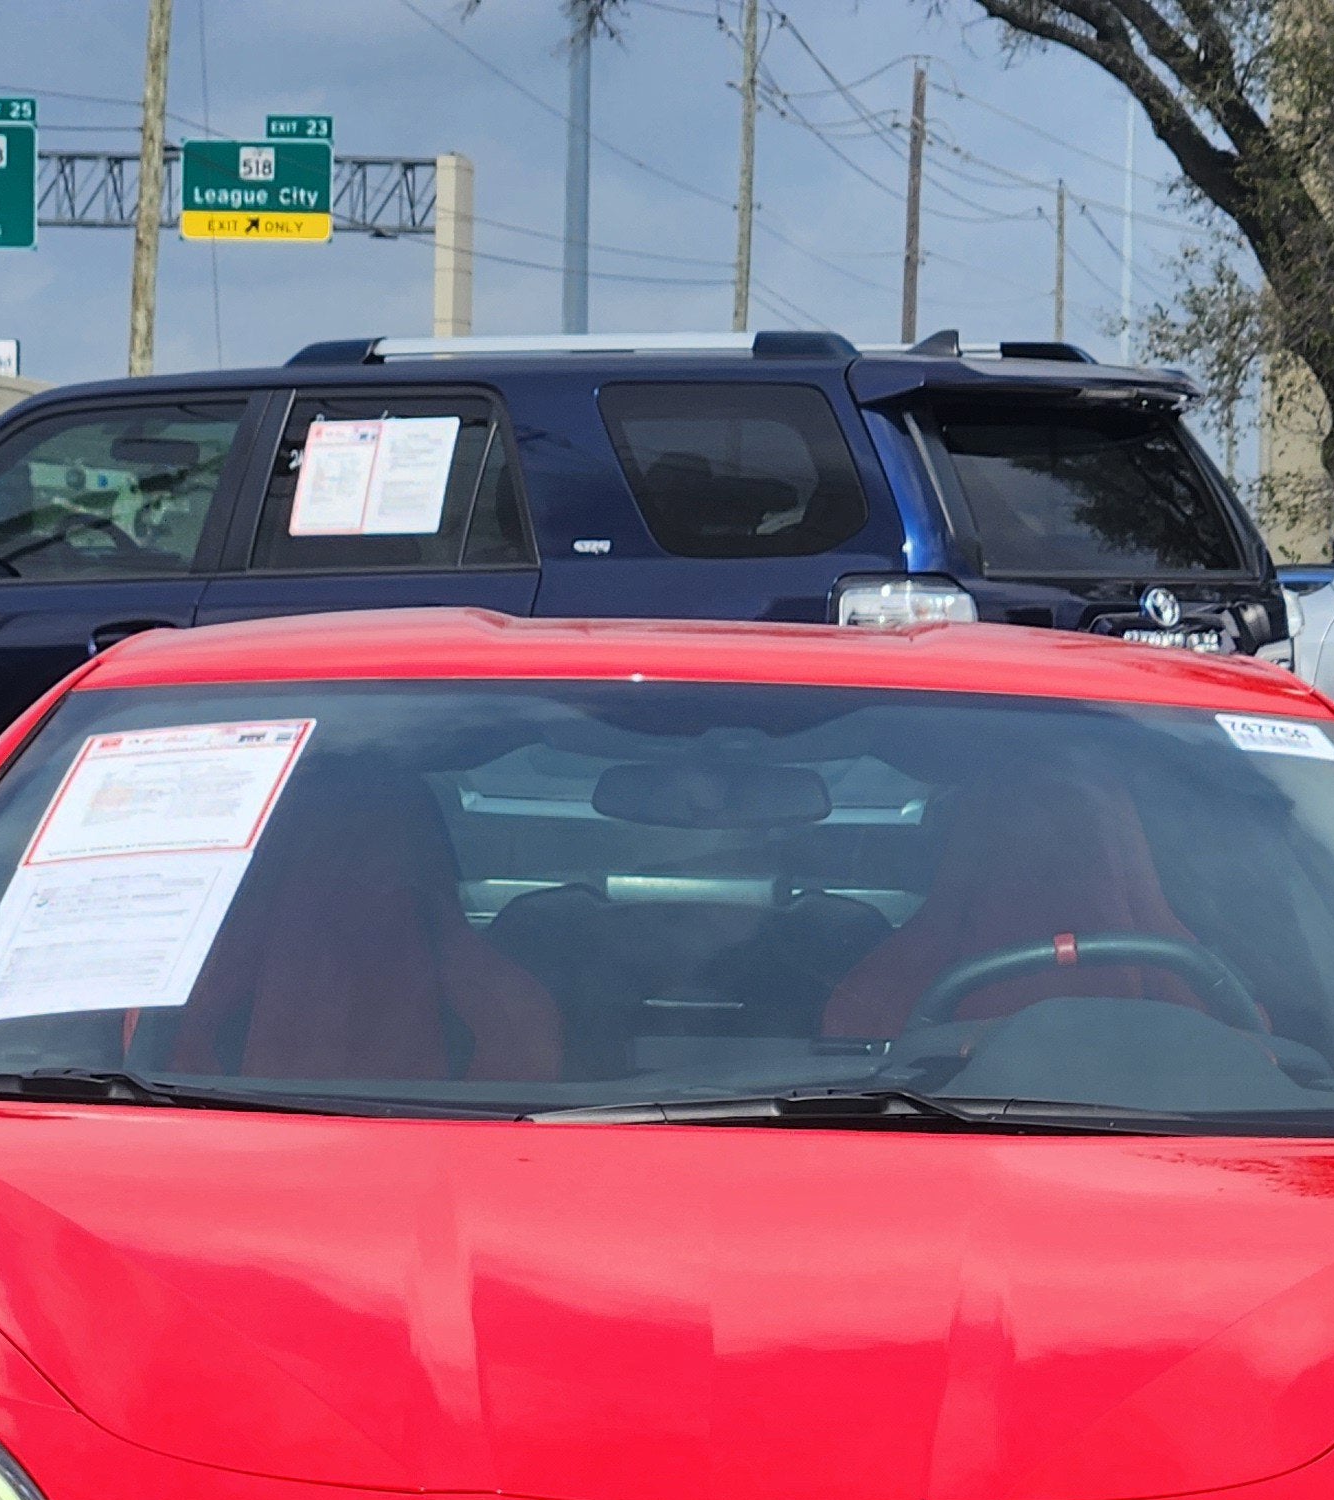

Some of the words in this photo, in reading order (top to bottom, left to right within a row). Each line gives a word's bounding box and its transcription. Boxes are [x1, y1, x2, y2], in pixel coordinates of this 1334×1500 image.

[9, 101, 32, 118] 25
[271, 121, 298, 134] EXIT
[306, 119, 328, 136] 23
[242, 158, 272, 176] 518
[193, 185, 268, 209] League
[279, 185, 319, 208] City
[208, 220, 238, 232] EXIT
[264, 221, 304, 233] ONLY
